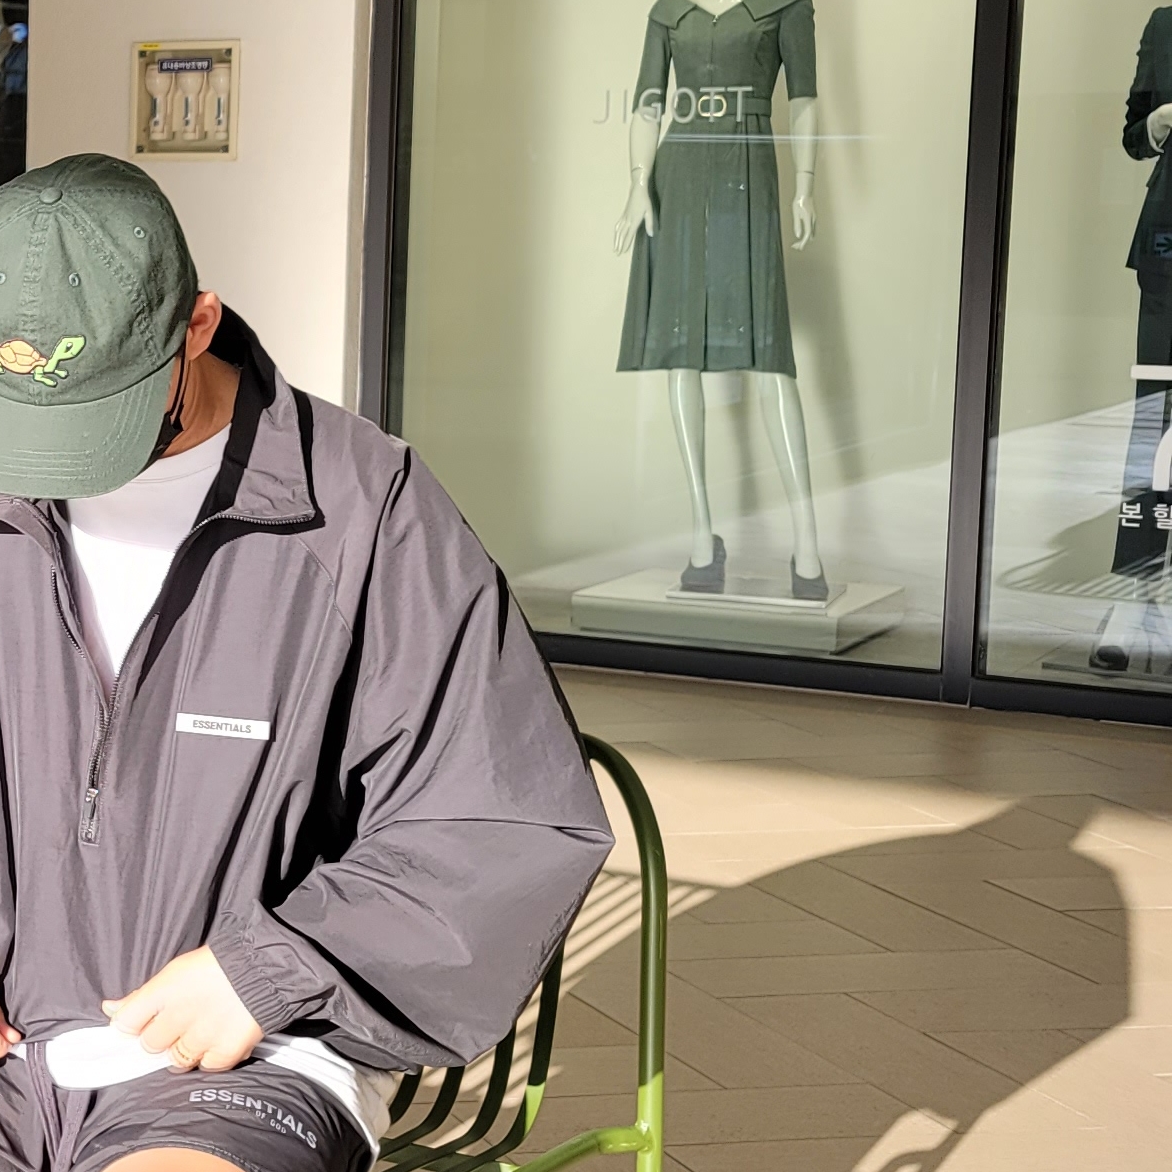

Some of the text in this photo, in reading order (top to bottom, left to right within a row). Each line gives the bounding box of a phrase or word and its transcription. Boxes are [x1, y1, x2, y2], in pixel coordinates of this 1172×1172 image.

[593, 86, 753, 124] JIGOTT
[1118, 502, 1143, 528] 본
[192, 719, 252, 734] ESSENTIALS
[189, 1088, 317, 1149] ESSENTIALS
[269, 1119, 287, 1134] GOD
